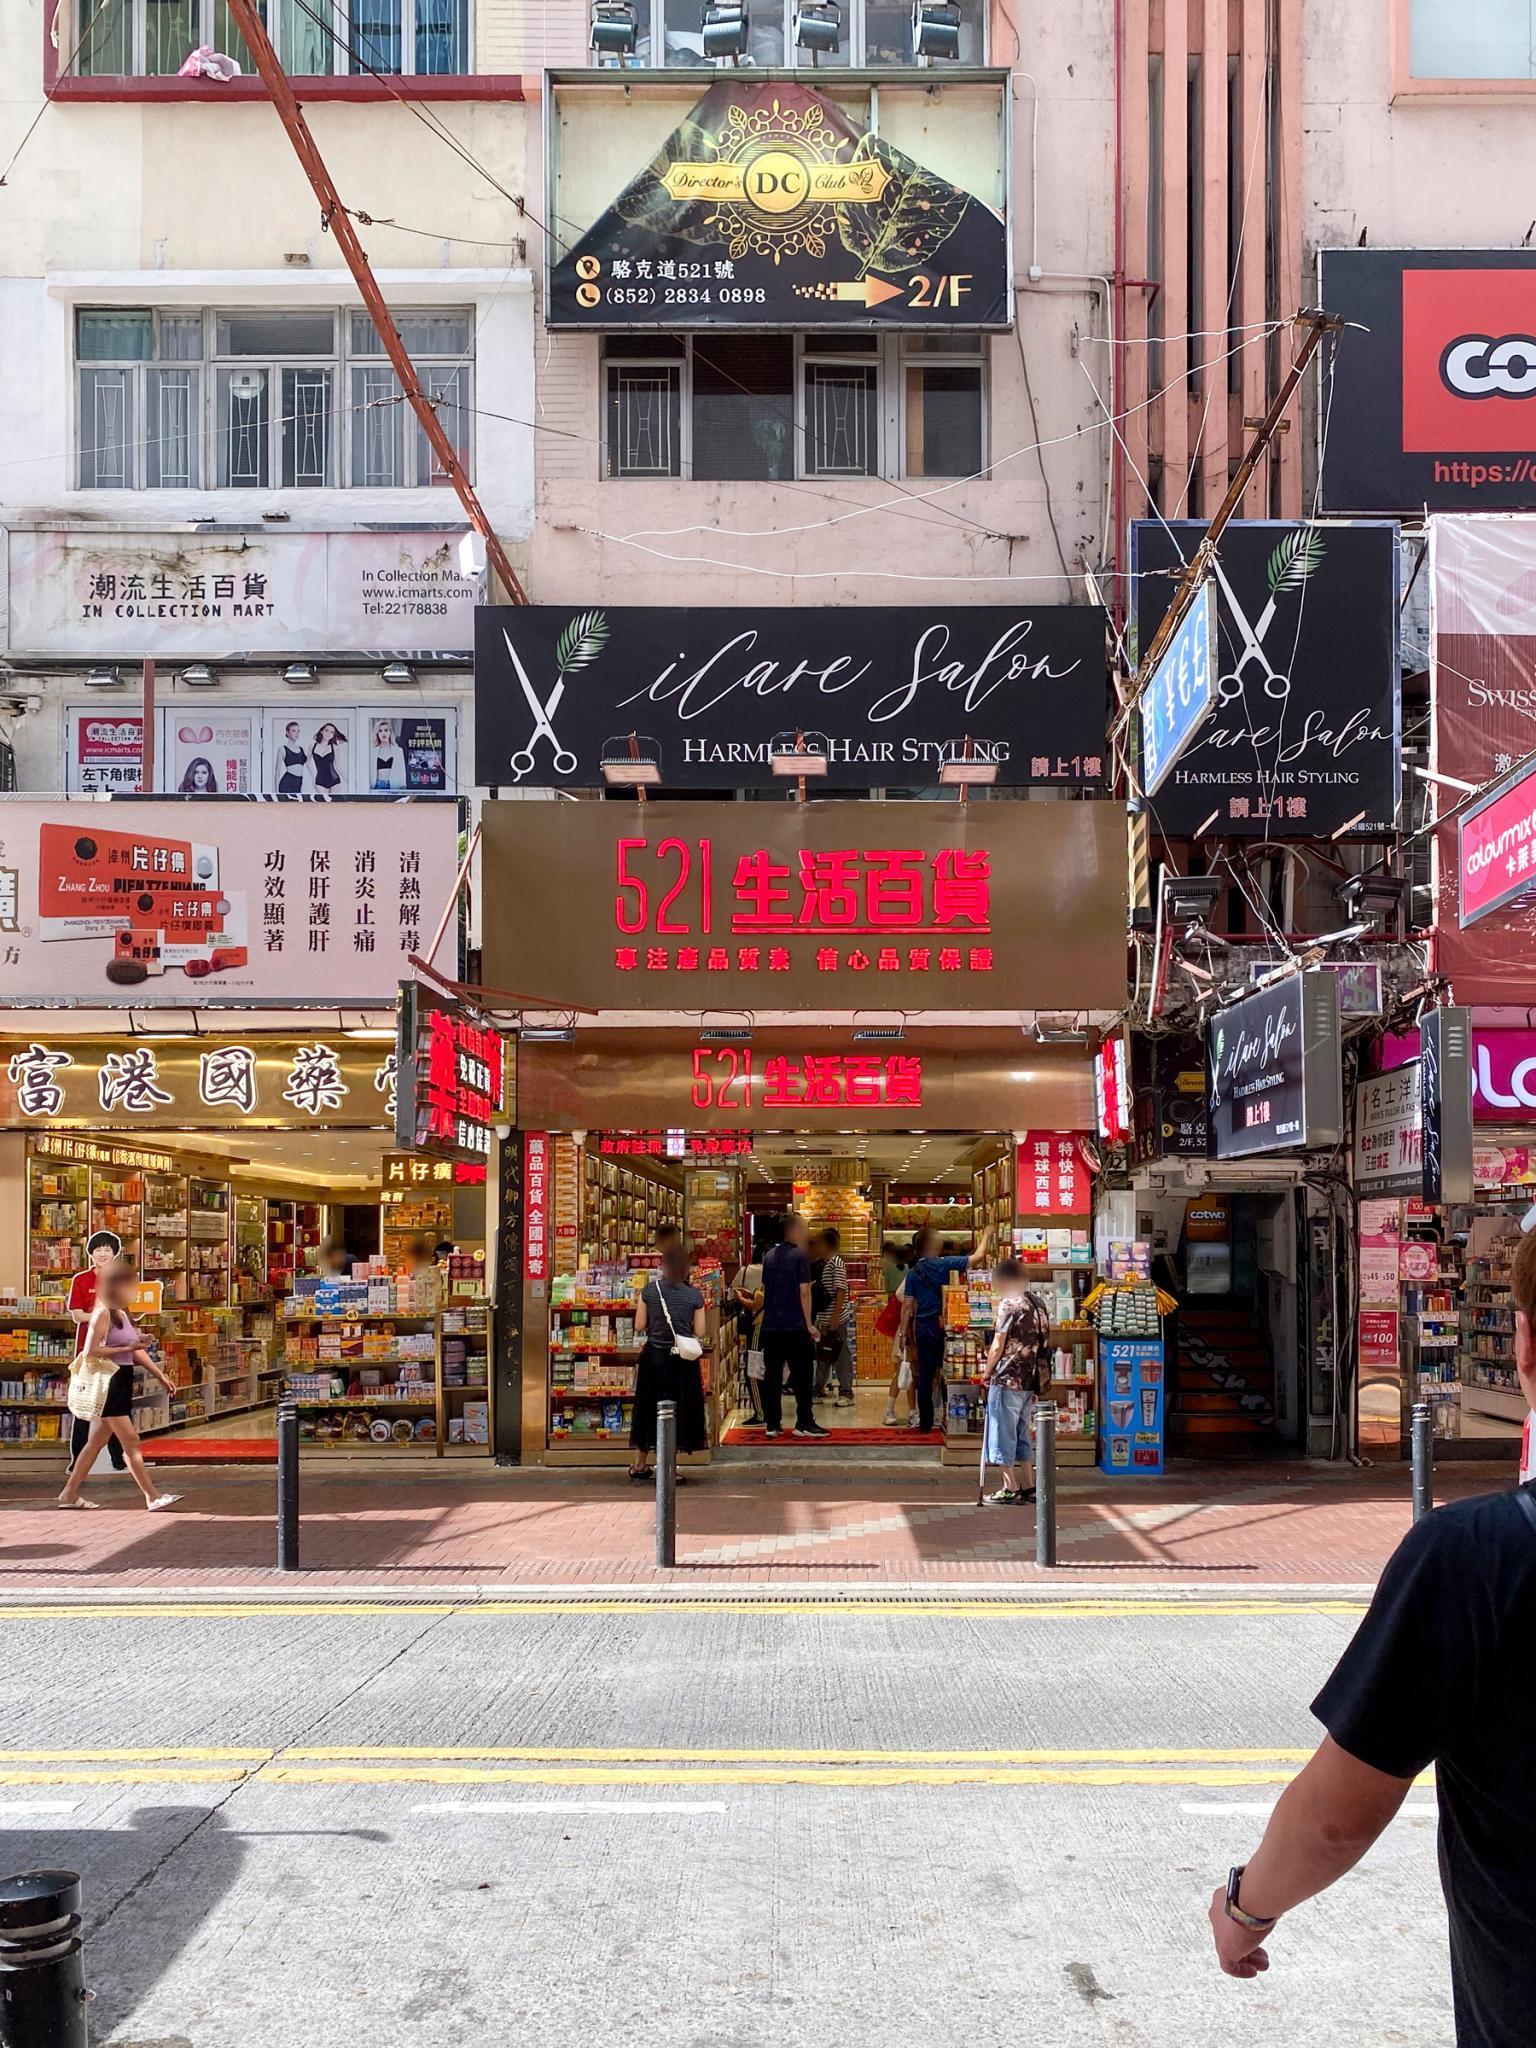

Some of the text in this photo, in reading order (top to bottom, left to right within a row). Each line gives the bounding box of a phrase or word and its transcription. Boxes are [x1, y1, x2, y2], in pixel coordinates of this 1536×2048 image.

[672, 170, 847, 194] Director's DC Club
[611, 259, 735, 280] 駱克道521號
[606, 287, 766, 304] (852) 2834 0898
[907, 274, 974, 308] 2/F
[89, 573, 269, 600] 潮流生活百貨
[362, 570, 374, 581] In
[377, 569, 438, 582] Collection
[362, 586, 473, 599] www.icmarts.com
[83, 603, 275, 618] IN COLLECTION MART
[362, 602, 448, 615] Tel:22178838
[867, 619, 1082, 723] Salon
[1278, 707, 1394, 763] Salon
[829, 738, 895, 763] HAIR
[1030, 756, 1102, 778] 請上1樓
[1174, 769, 1360, 785] HARMLESS HAIR STYLING
[1229, 796, 1308, 820] 請上1樓
[58, 876, 86, 892] ZHANG
[88, 877, 110, 893] ZHOU
[264, 849, 285, 952] 功效顯著
[308, 849, 330, 952] 保肝護肝
[353, 850, 376, 952] 消炎止痛
[399, 850, 421, 952] 清熱解毒
[815, 947, 994, 972] 信心品質保證
[1034, 1141, 1051, 1209] 環球西藥
[1058, 1141, 1075, 1208] 特快郵寄
[528, 1140, 545, 1276] 藥品百貨 全國郵寄
[1111, 1344, 1136, 1357] 521
[1372, 1333, 1394, 1344] 100
